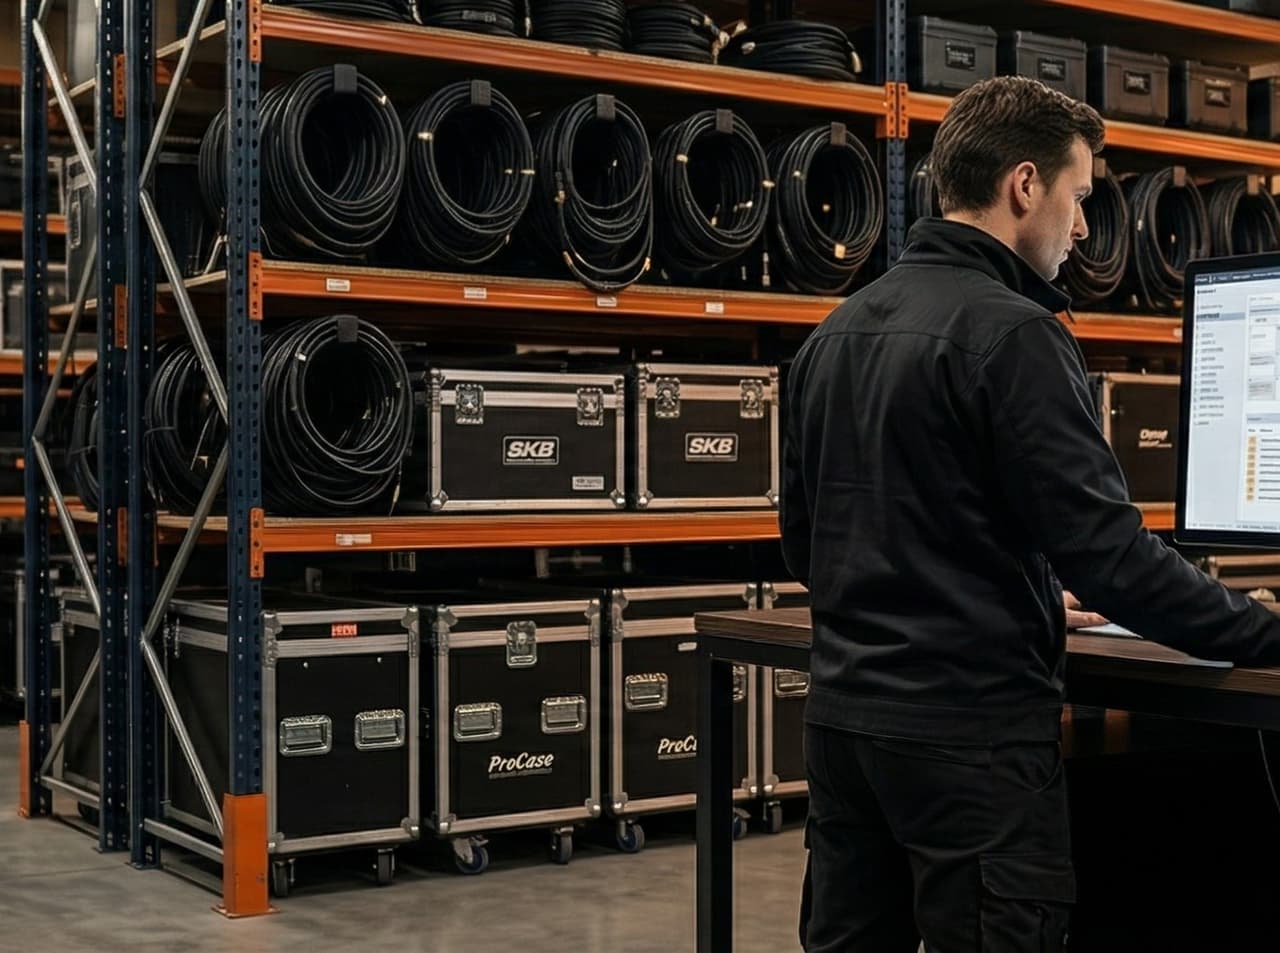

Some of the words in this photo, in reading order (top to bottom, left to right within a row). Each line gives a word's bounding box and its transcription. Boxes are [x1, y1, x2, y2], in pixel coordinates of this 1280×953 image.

[507, 441, 555, 457] SKB
[689, 437, 733, 454] SKB
[488, 752, 554, 773] ProCase
